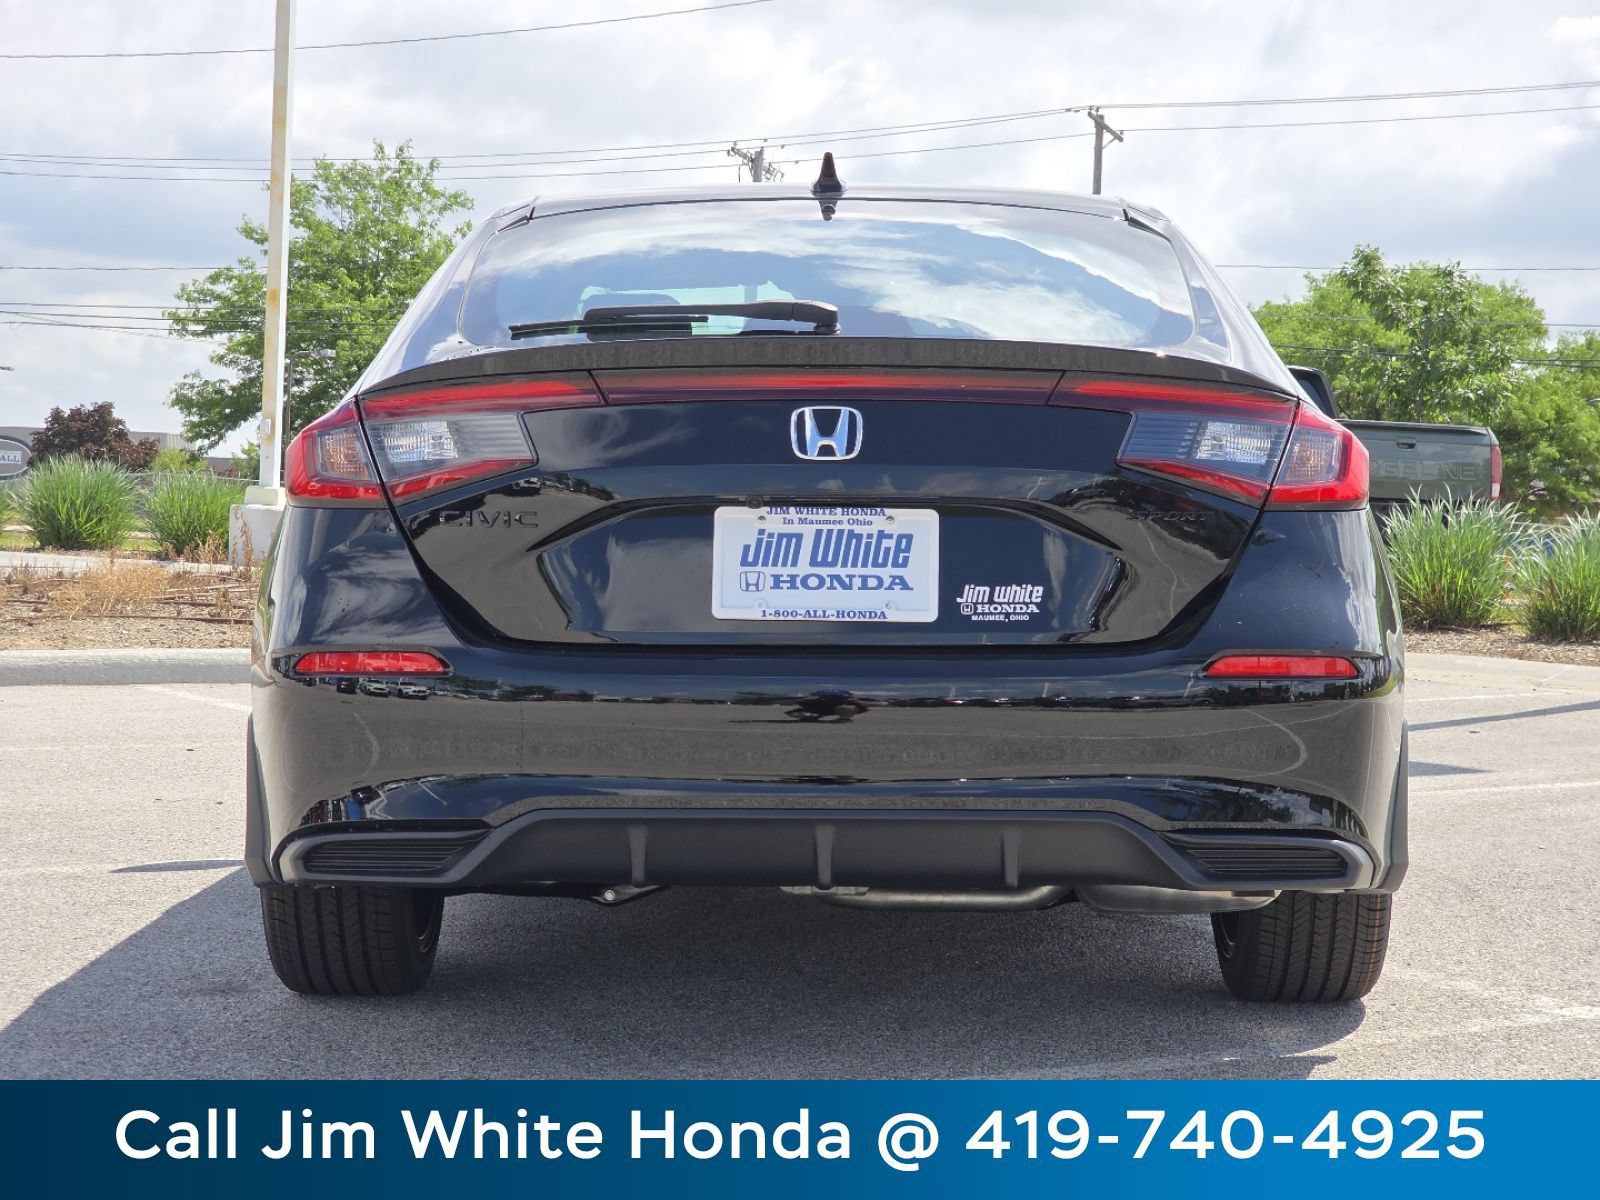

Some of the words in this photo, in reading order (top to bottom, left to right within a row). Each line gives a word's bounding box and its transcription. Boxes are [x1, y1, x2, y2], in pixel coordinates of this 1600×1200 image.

[767, 507, 790, 516] JIM
[795, 507, 837, 516] WHITE
[841, 508, 887, 517] HONDA
[1127, 511, 1215, 521] SPORT
[440, 510, 538, 528] CIVIC
[783, 517, 794, 525] In
[798, 517, 844, 526] Maumee
[847, 517, 873, 526] Ohio
[810, 529, 914, 569] White
[769, 573, 914, 591] HONDA
[956, 584, 990, 603] Jim
[976, 603, 1040, 613] HONDA
[760, 609, 888, 620] 1-800-ALL-HONDA
